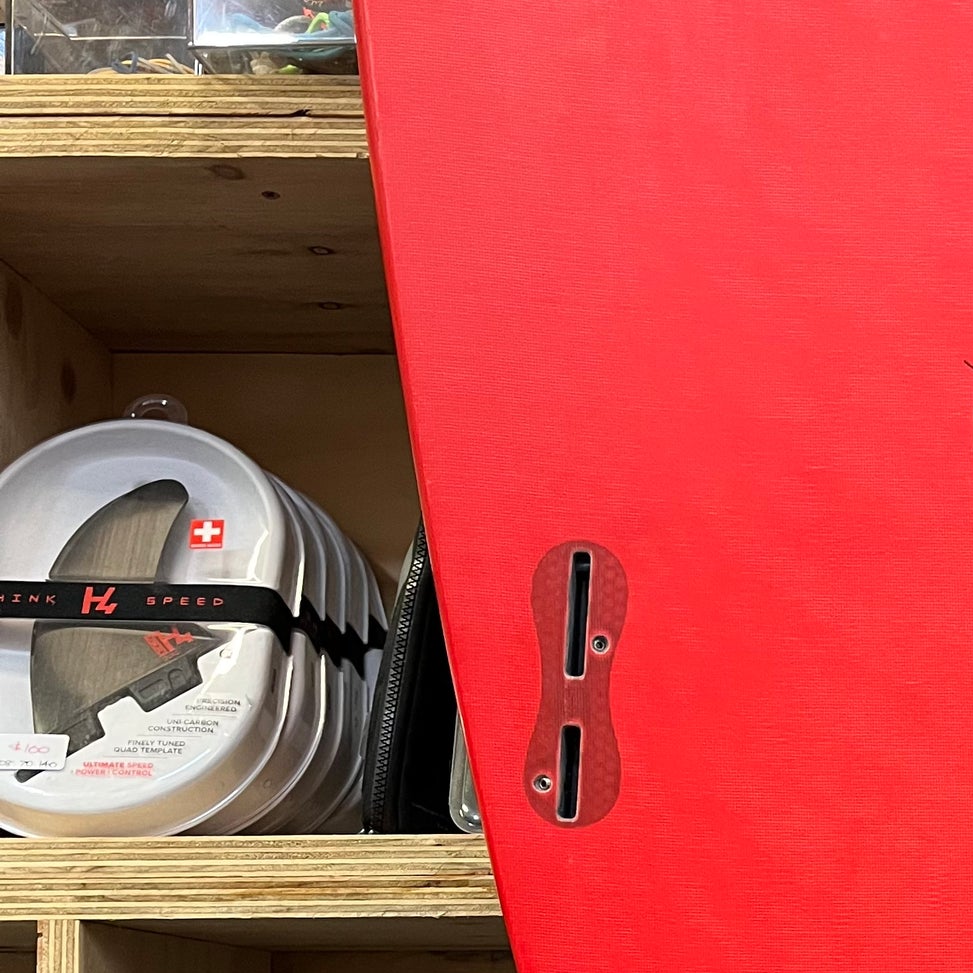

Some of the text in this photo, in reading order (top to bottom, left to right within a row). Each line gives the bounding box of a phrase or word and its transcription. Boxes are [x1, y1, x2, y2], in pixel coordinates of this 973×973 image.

[146, 596, 225, 607] SPEED
[185, 705, 238, 713] ENGINEERED
[148, 725, 214, 733] CONSTRUCTION
[127, 739, 155, 747] FINELY
[141, 746, 183, 755] TEMPLATE
[83, 761, 154, 770] ULTIMATE SPEED
[112, 769, 153, 777] CONTROL
